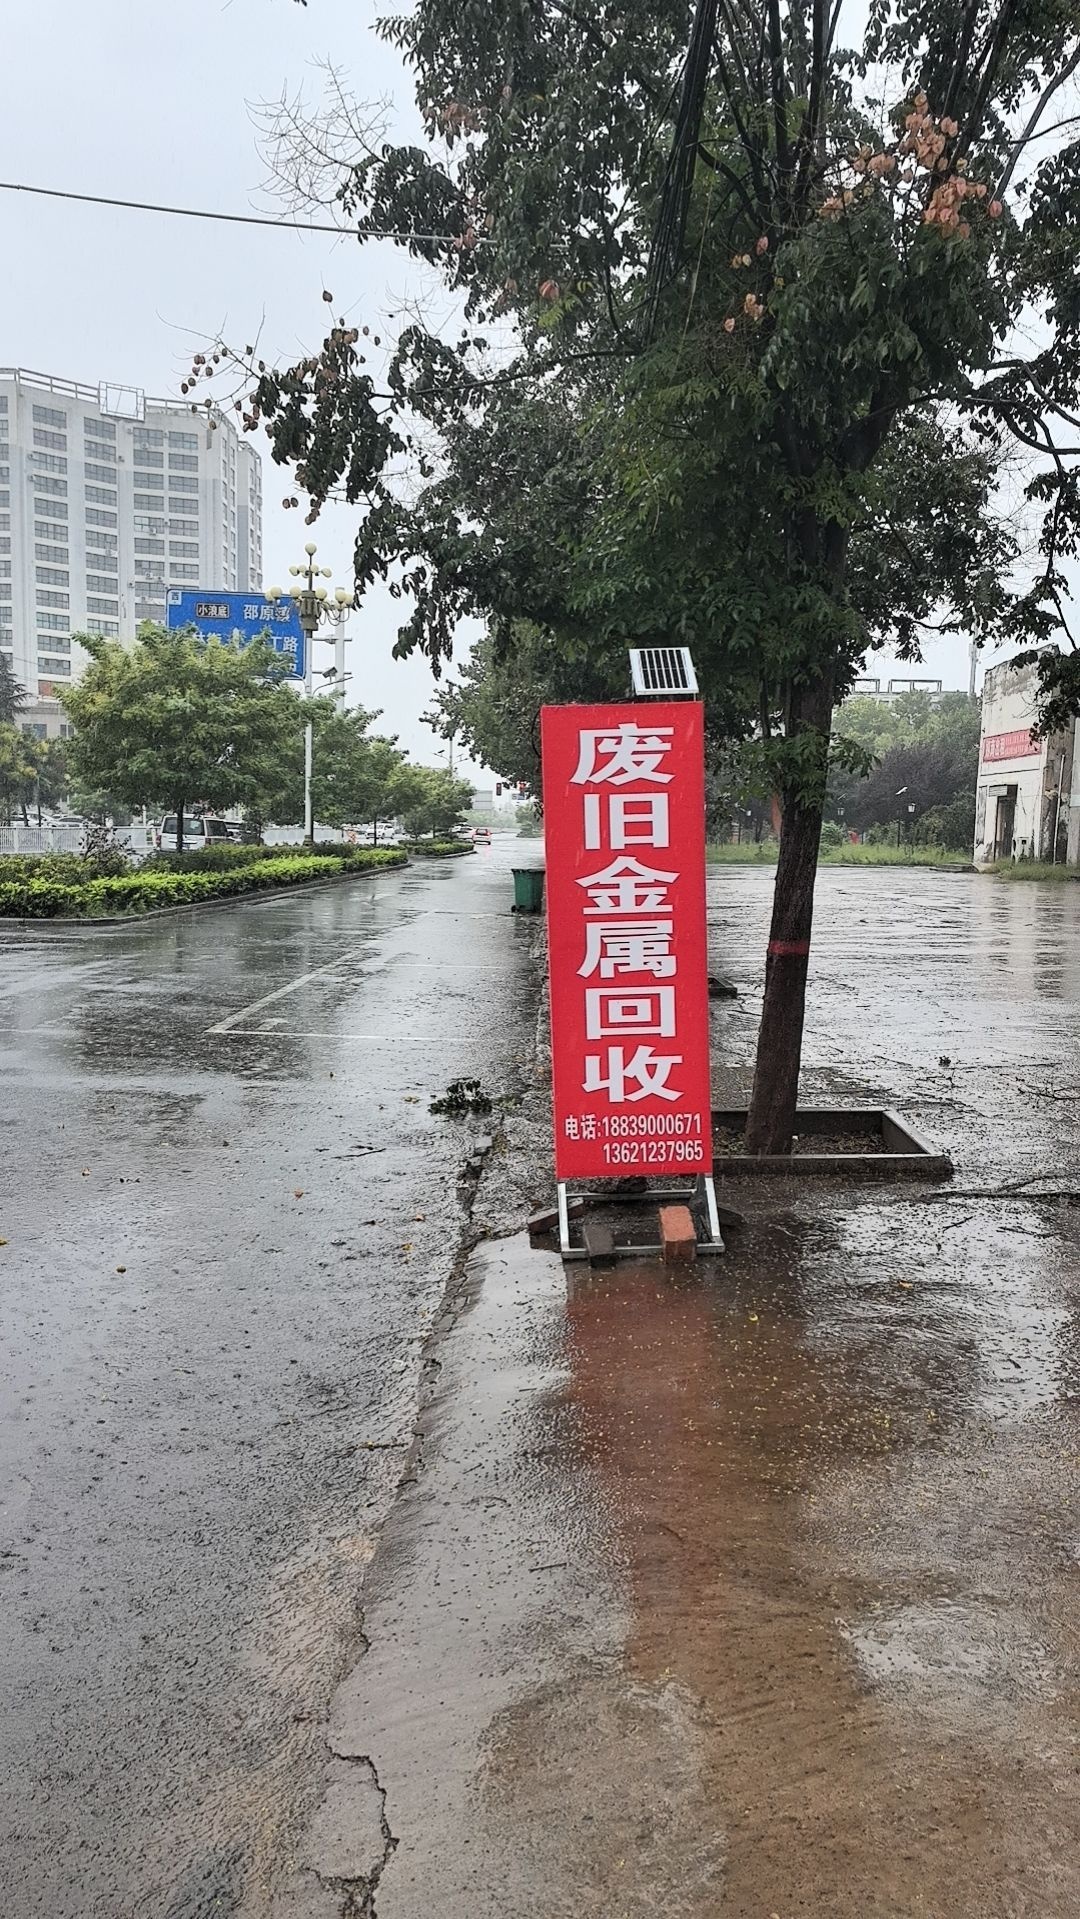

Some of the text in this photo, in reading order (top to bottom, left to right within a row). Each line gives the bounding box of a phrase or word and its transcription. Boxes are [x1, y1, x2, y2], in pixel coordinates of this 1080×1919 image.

[198, 604, 227, 617] 小浪底
[570, 722, 684, 1103] 废旧金属回收
[603, 1140, 704, 1163] 13621237965
